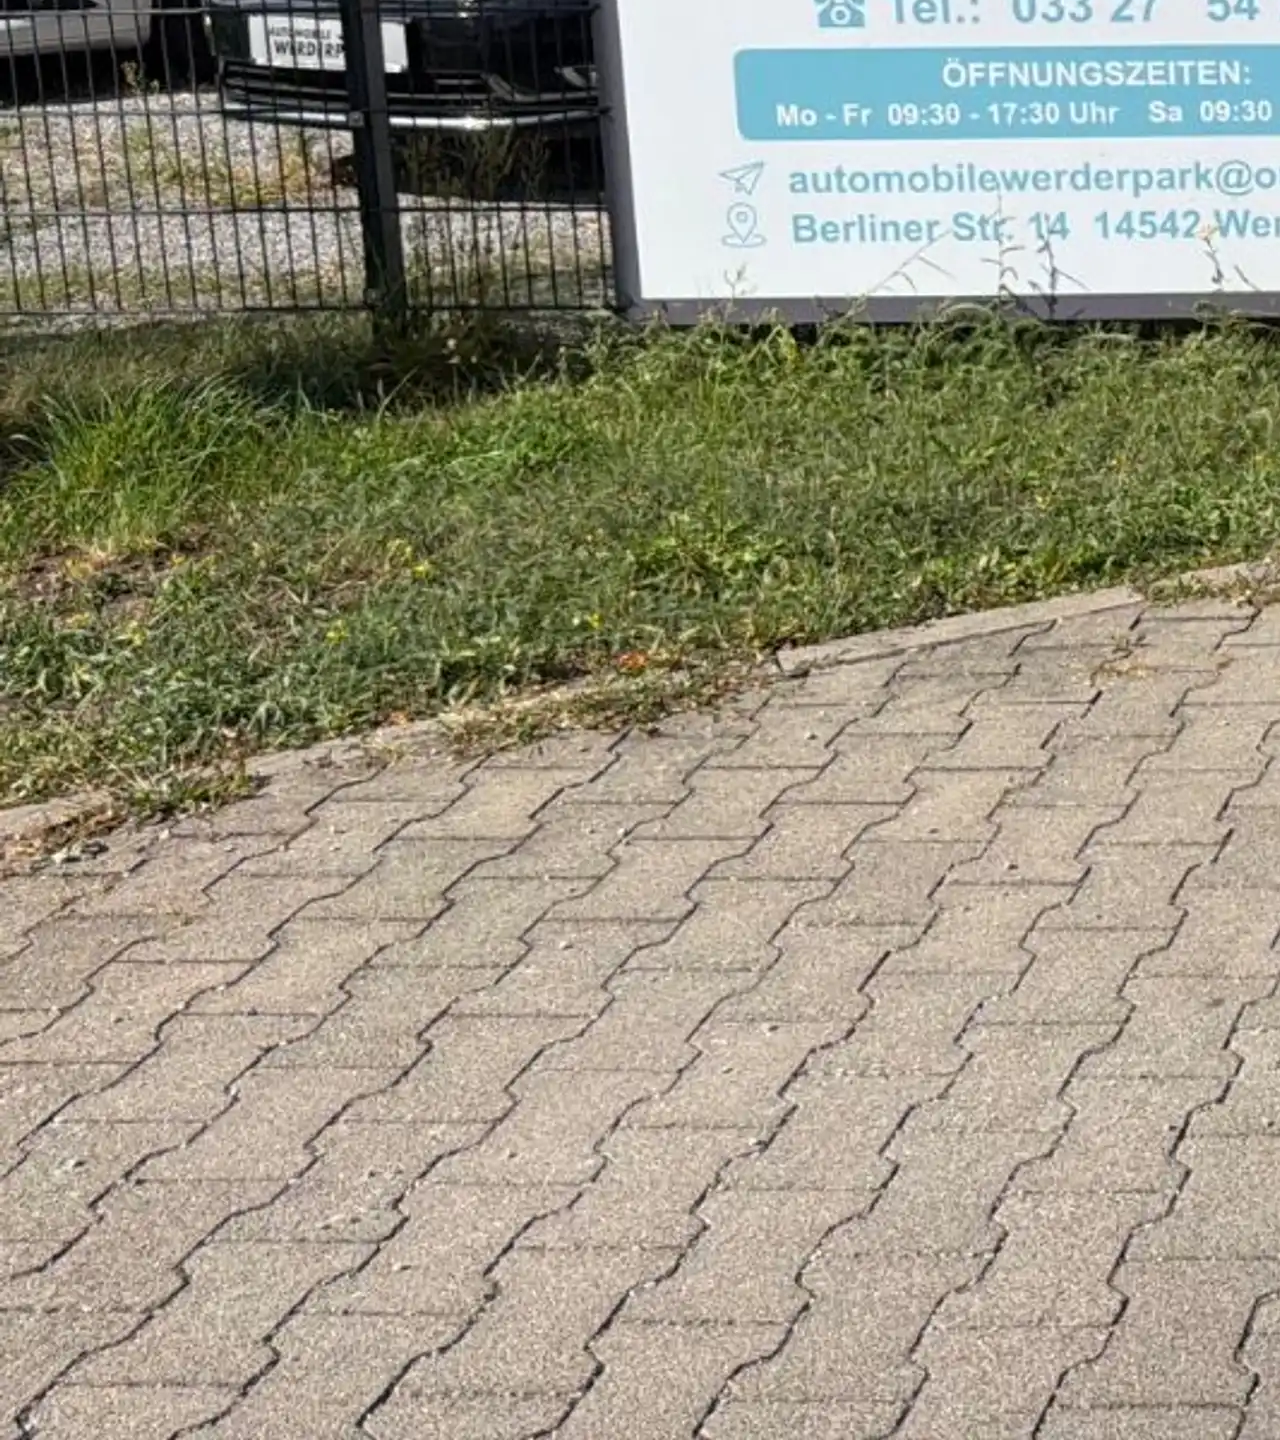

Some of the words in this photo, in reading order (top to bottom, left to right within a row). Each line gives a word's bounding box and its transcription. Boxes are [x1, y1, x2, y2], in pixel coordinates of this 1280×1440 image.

[942, 58, 1252, 88] ÖFFNUNGSZEITEN:
[776, 104, 818, 126] Mo
[843, 104, 873, 126] Fr
[887, 103, 960, 126] 09:30
[988, 103, 1060, 125] 17:30
[1069, 101, 1119, 124] Uhr
[1148, 100, 1183, 123] Sa
[1200, 100, 1273, 122] 09:30
[791, 212, 941, 244] Berliner
[952, 210, 1015, 242] Str.
[1028, 210, 1071, 242] 14
[1094, 209, 1200, 240] 14542
